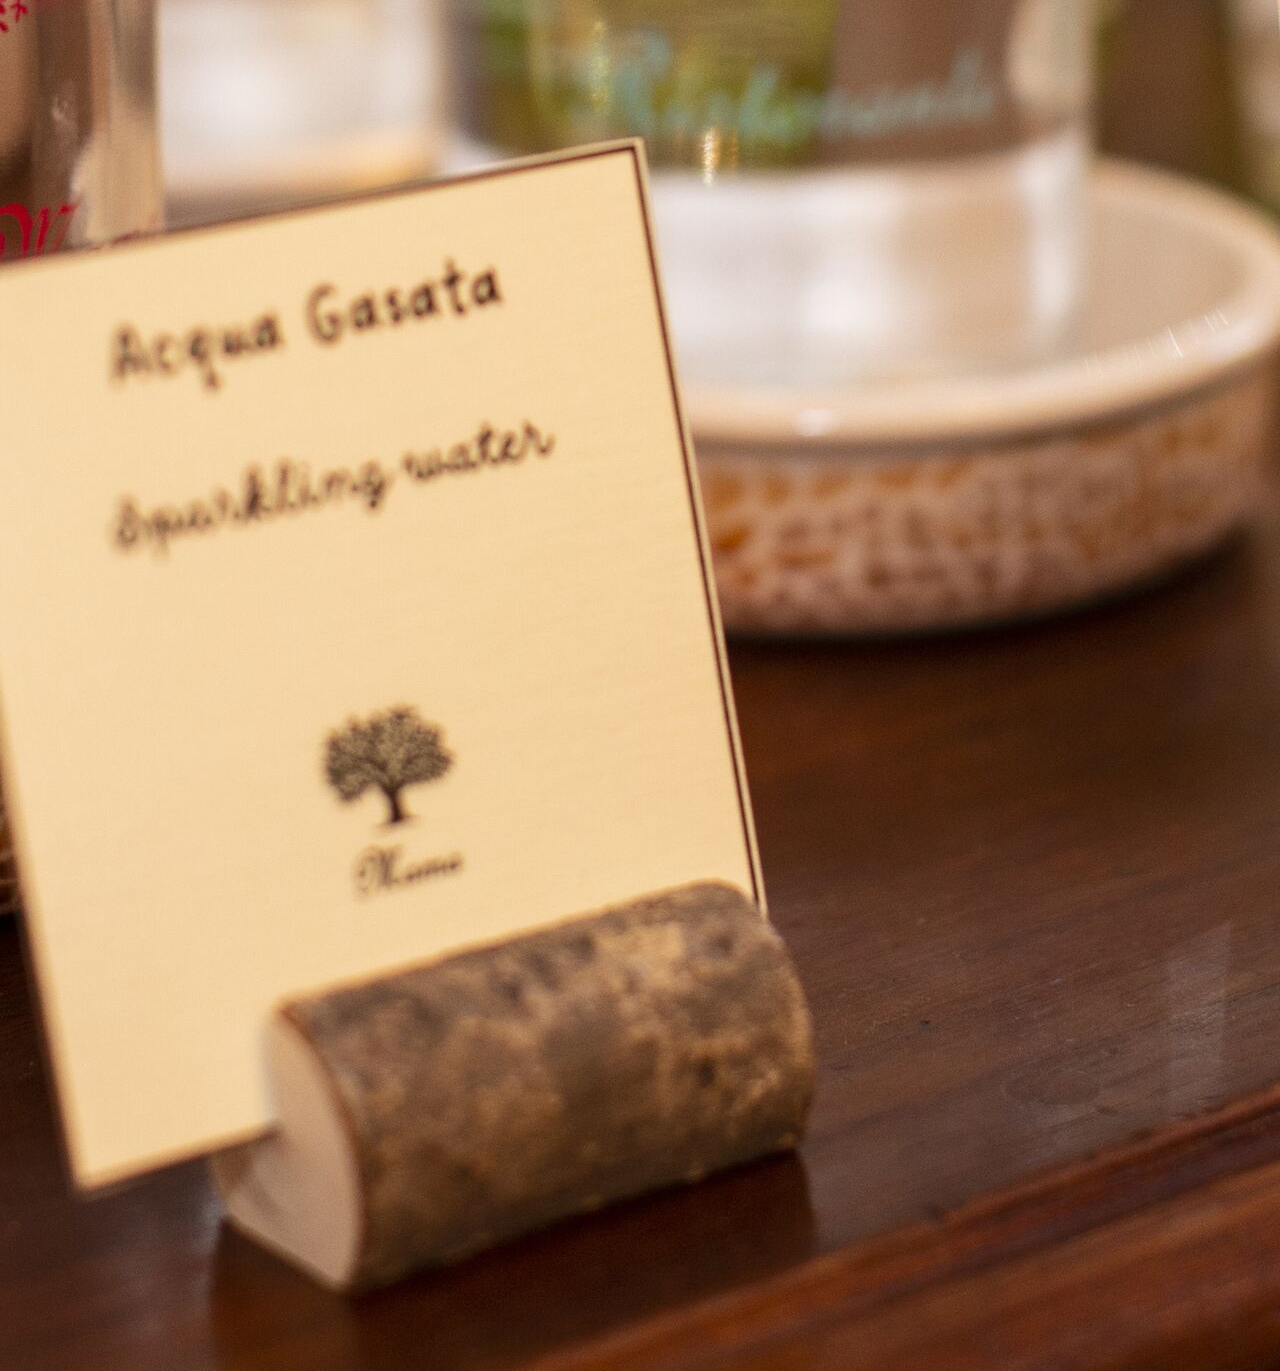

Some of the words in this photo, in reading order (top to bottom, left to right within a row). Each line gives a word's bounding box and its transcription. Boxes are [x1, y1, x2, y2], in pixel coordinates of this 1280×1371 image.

[111, 313, 285, 392] Acqua
[306, 259, 503, 346] Gasata
[402, 420, 555, 485] water
